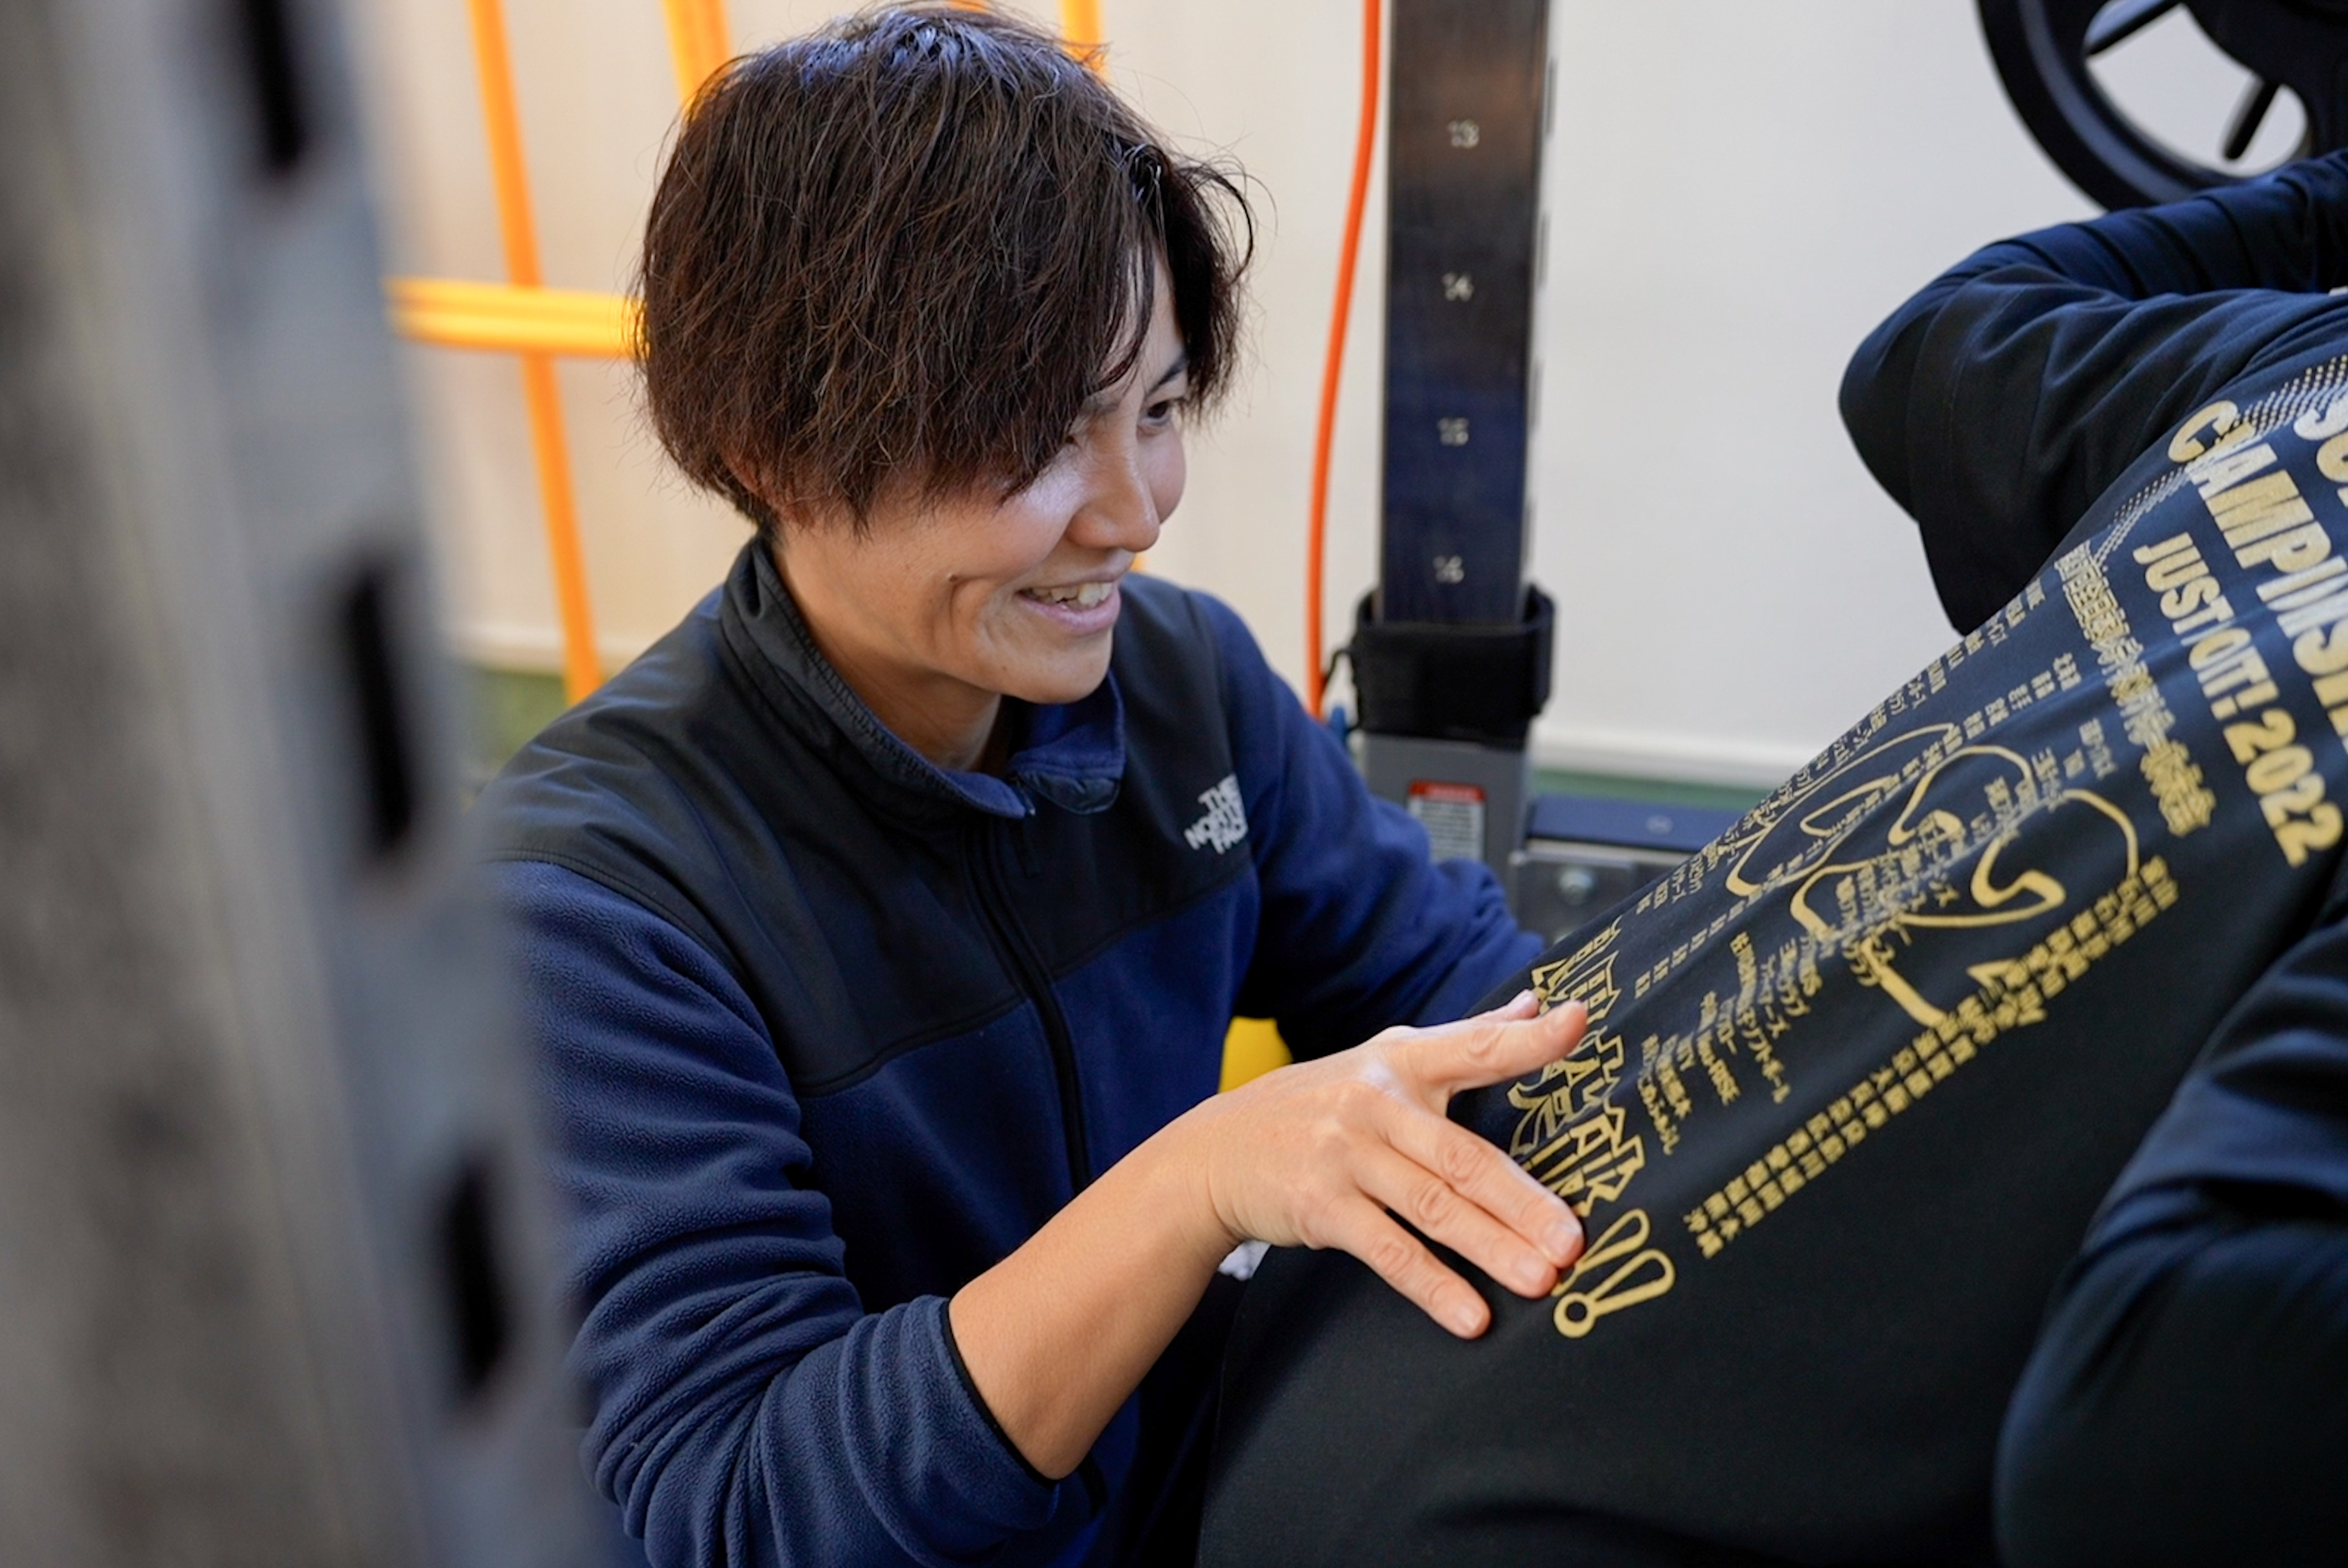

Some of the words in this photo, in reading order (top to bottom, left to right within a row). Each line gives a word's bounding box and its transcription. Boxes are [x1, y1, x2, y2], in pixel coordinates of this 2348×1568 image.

[1441, 272, 1475, 302] 14
[2133, 533, 2235, 635] JUST
[2221, 714, 2344, 868] 2022
[1196, 772, 1241, 811] THE
